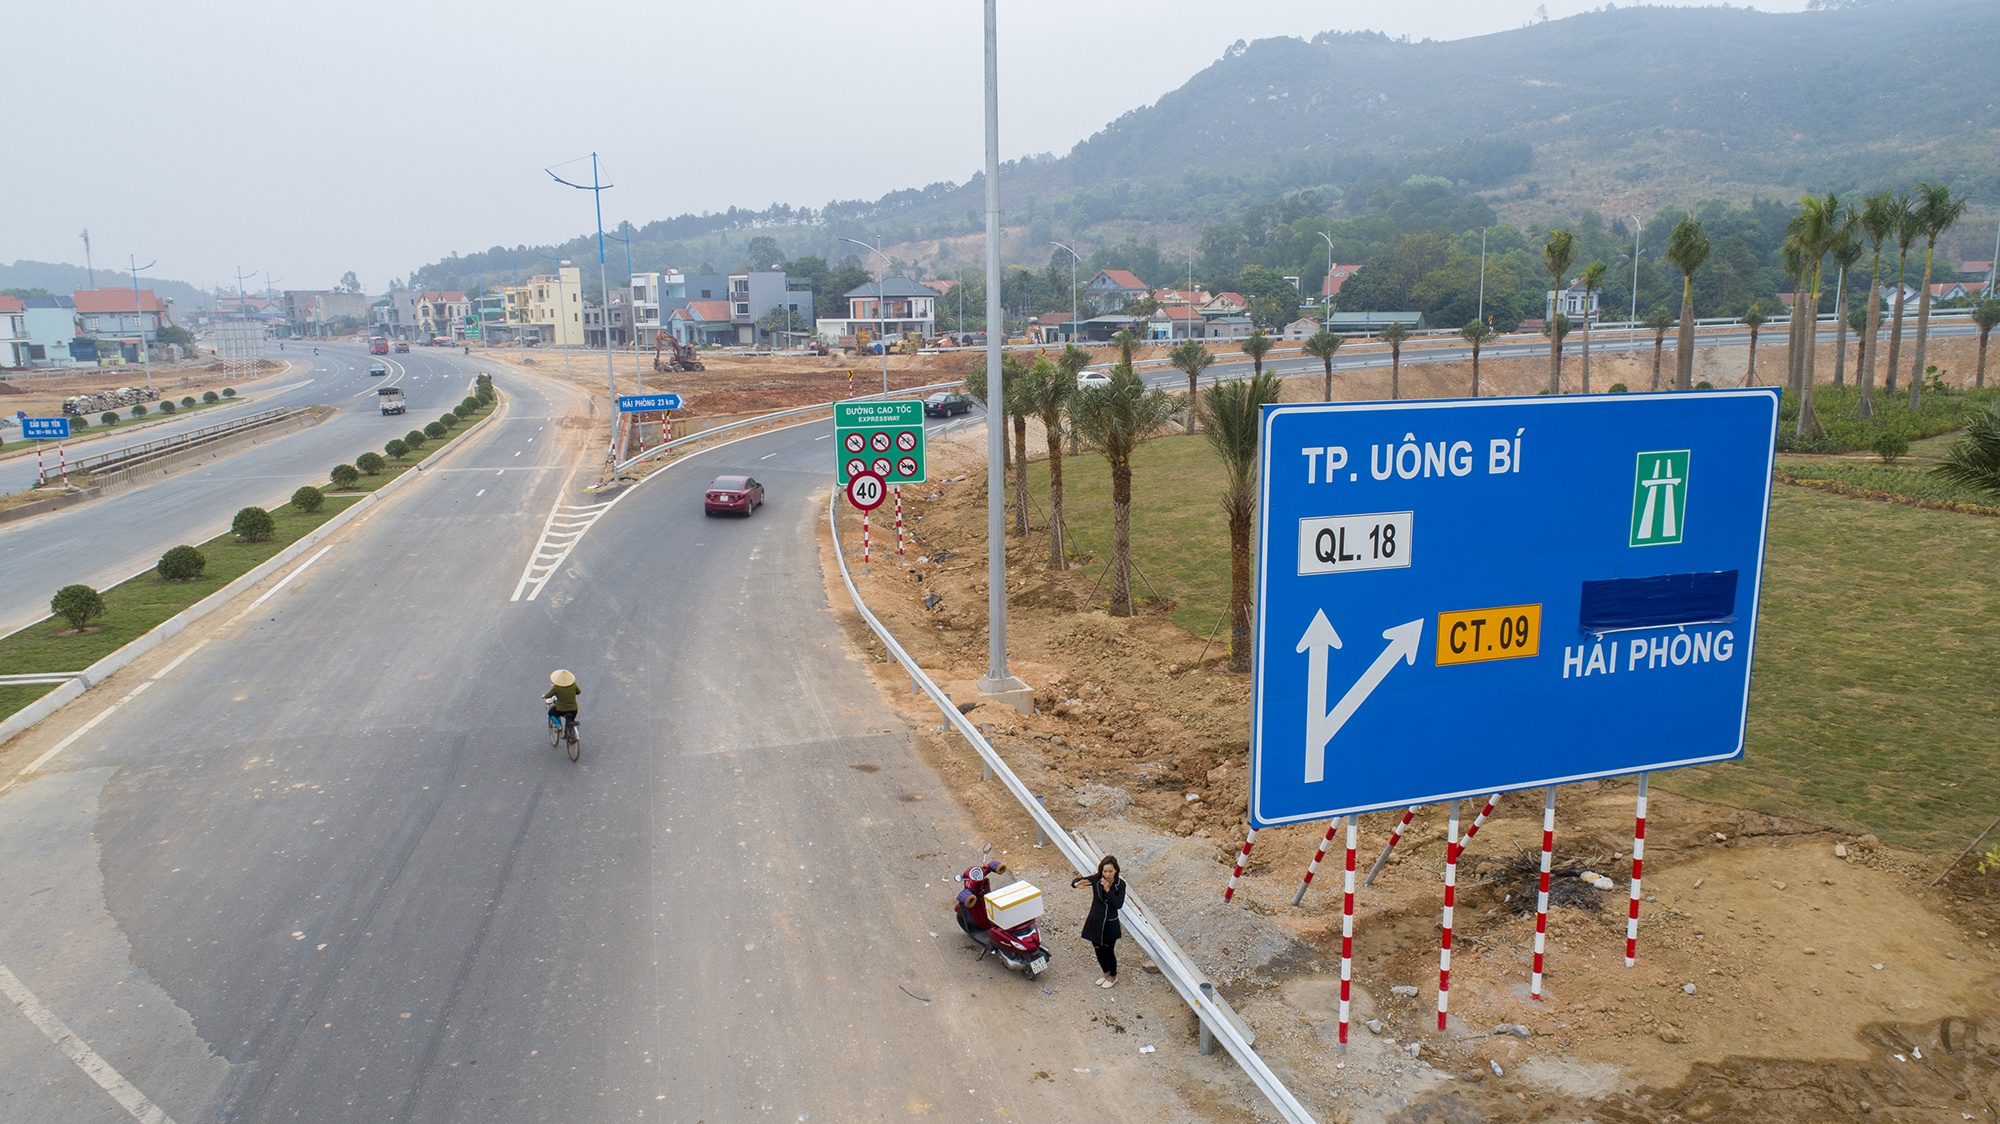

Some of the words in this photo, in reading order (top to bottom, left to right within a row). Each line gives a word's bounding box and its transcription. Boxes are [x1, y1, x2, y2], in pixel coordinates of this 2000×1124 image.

[622, 398, 633, 408] HẢI
[634, 397, 656, 407] PHÒNG
[657, 398, 665, 406] 23
[665, 398, 675, 406] km
[845, 405, 875, 416] ĐƯỜNG
[876, 406, 893, 415] CAO
[895, 403, 912, 414] TỐC
[858, 415, 901, 423] EXPRESSWAY
[1301, 446, 1358, 485] TP.
[1371, 432, 1474, 481] UÔNG
[1488, 427, 1526, 475] BÍ
[856, 481, 877, 499] 40
[1562, 633, 1618, 679] HẢI
[1628, 624, 1735, 672] PHÒNG
